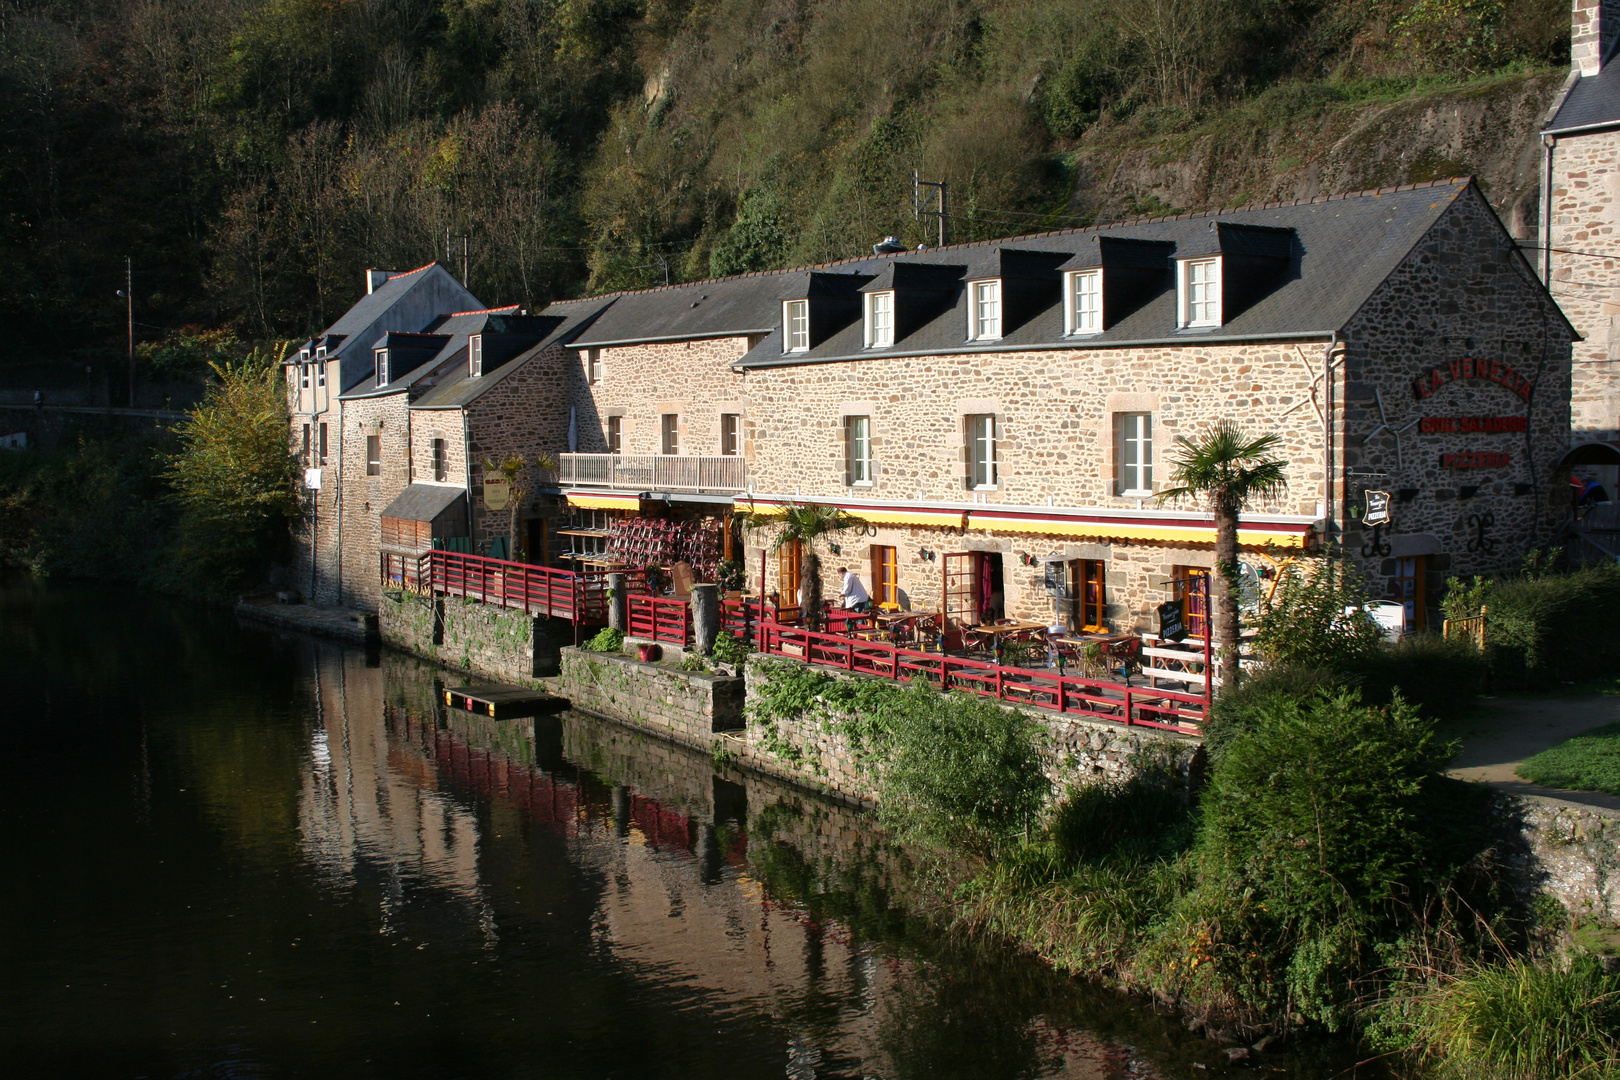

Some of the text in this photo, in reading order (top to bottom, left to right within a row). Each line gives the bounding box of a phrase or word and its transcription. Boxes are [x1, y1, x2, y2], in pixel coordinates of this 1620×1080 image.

[1418, 358, 1530, 401] LA VENEZIA
[1421, 417, 1527, 432] GRILL SALADERIE
[1444, 452, 1511, 468] PIZZERIA
[1368, 510, 1386, 520] PIZZERIA
[1162, 622, 1182, 638] PIZZERIA
